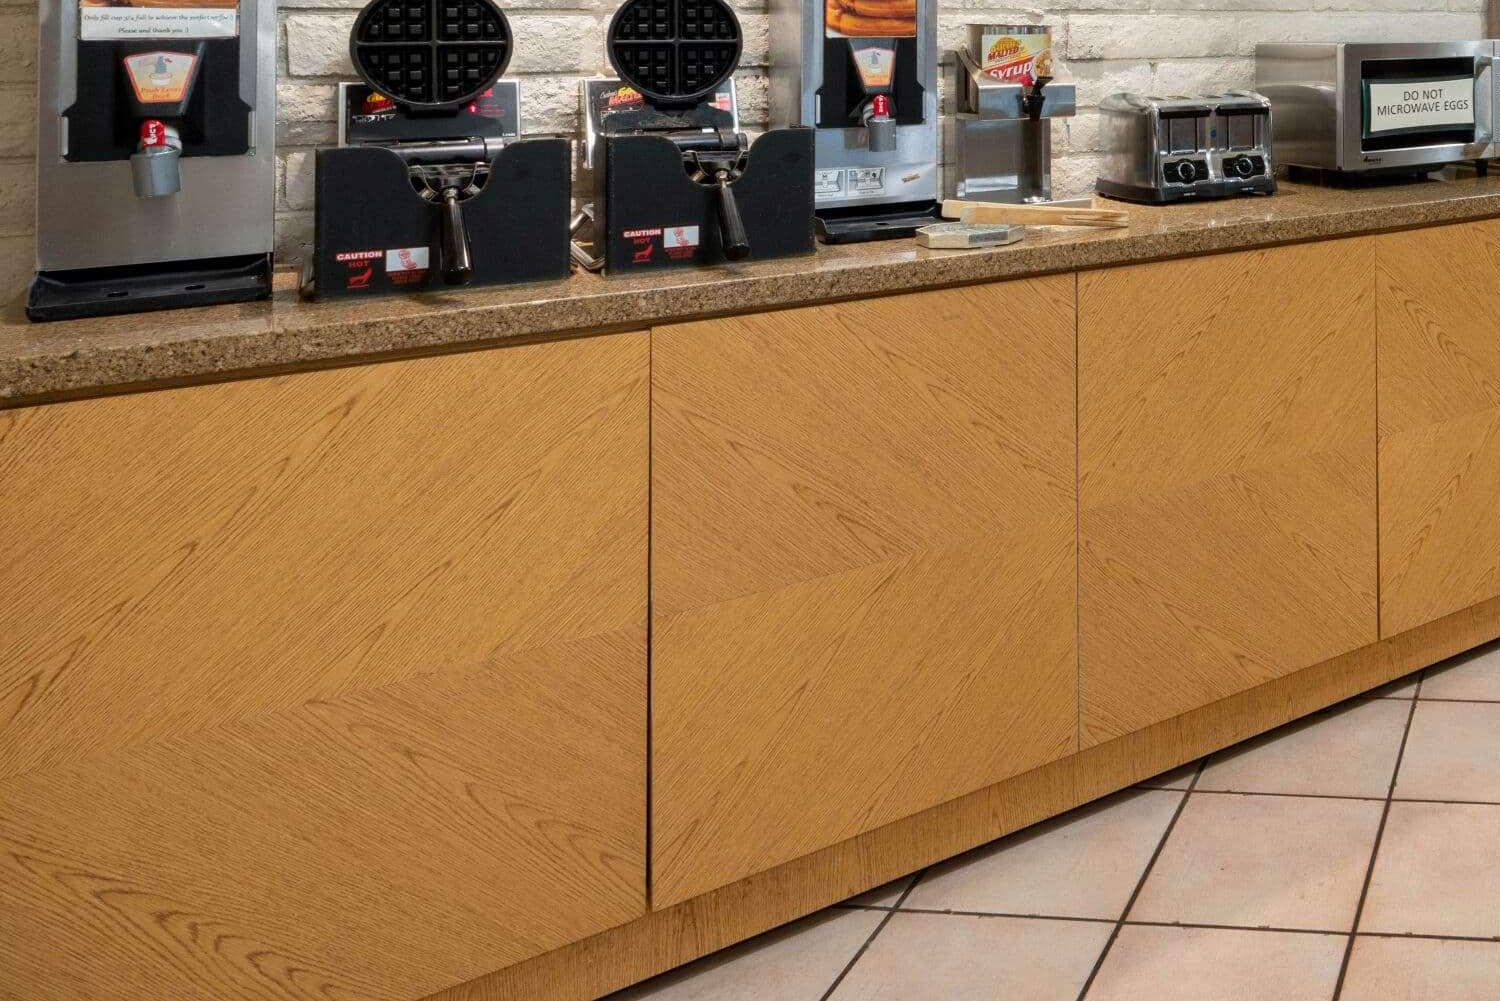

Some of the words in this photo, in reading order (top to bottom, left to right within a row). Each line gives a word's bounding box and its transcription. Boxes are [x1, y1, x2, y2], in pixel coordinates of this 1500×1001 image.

[1403, 90, 1419, 101] DO
[1422, 88, 1443, 100] NOT
[1377, 101, 1440, 116] MICROWAVE
[1444, 100, 1470, 111] EGGS
[623, 229, 661, 238] CAUTION
[336, 250, 383, 262] CAUTION
